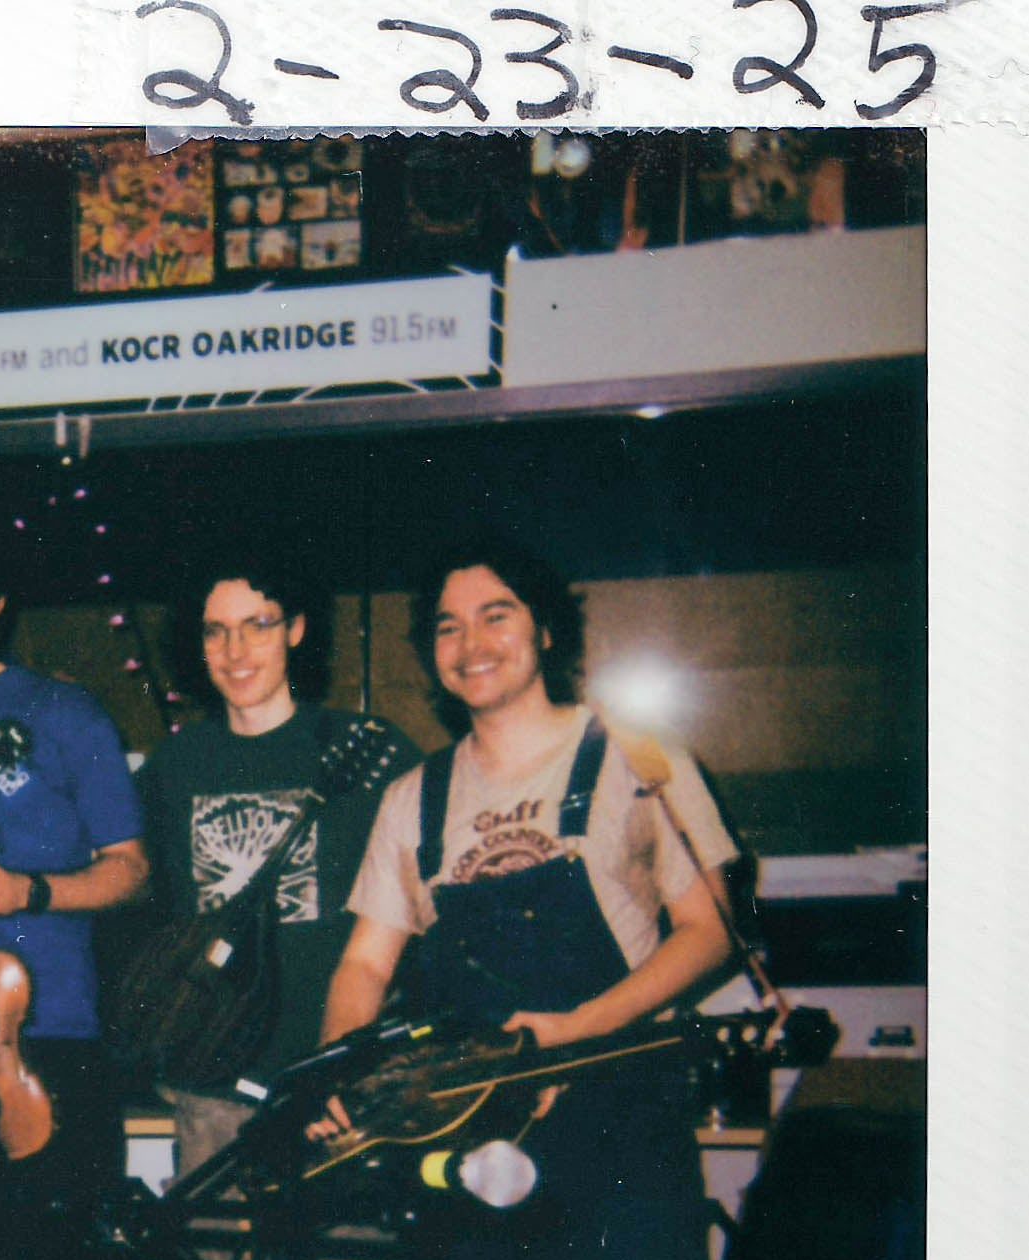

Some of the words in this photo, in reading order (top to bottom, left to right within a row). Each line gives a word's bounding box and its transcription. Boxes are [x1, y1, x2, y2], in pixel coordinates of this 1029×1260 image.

[39, 340, 88, 369] and
[101, 334, 181, 364] KOCR
[192, 320, 357, 357] OAKRIDGE
